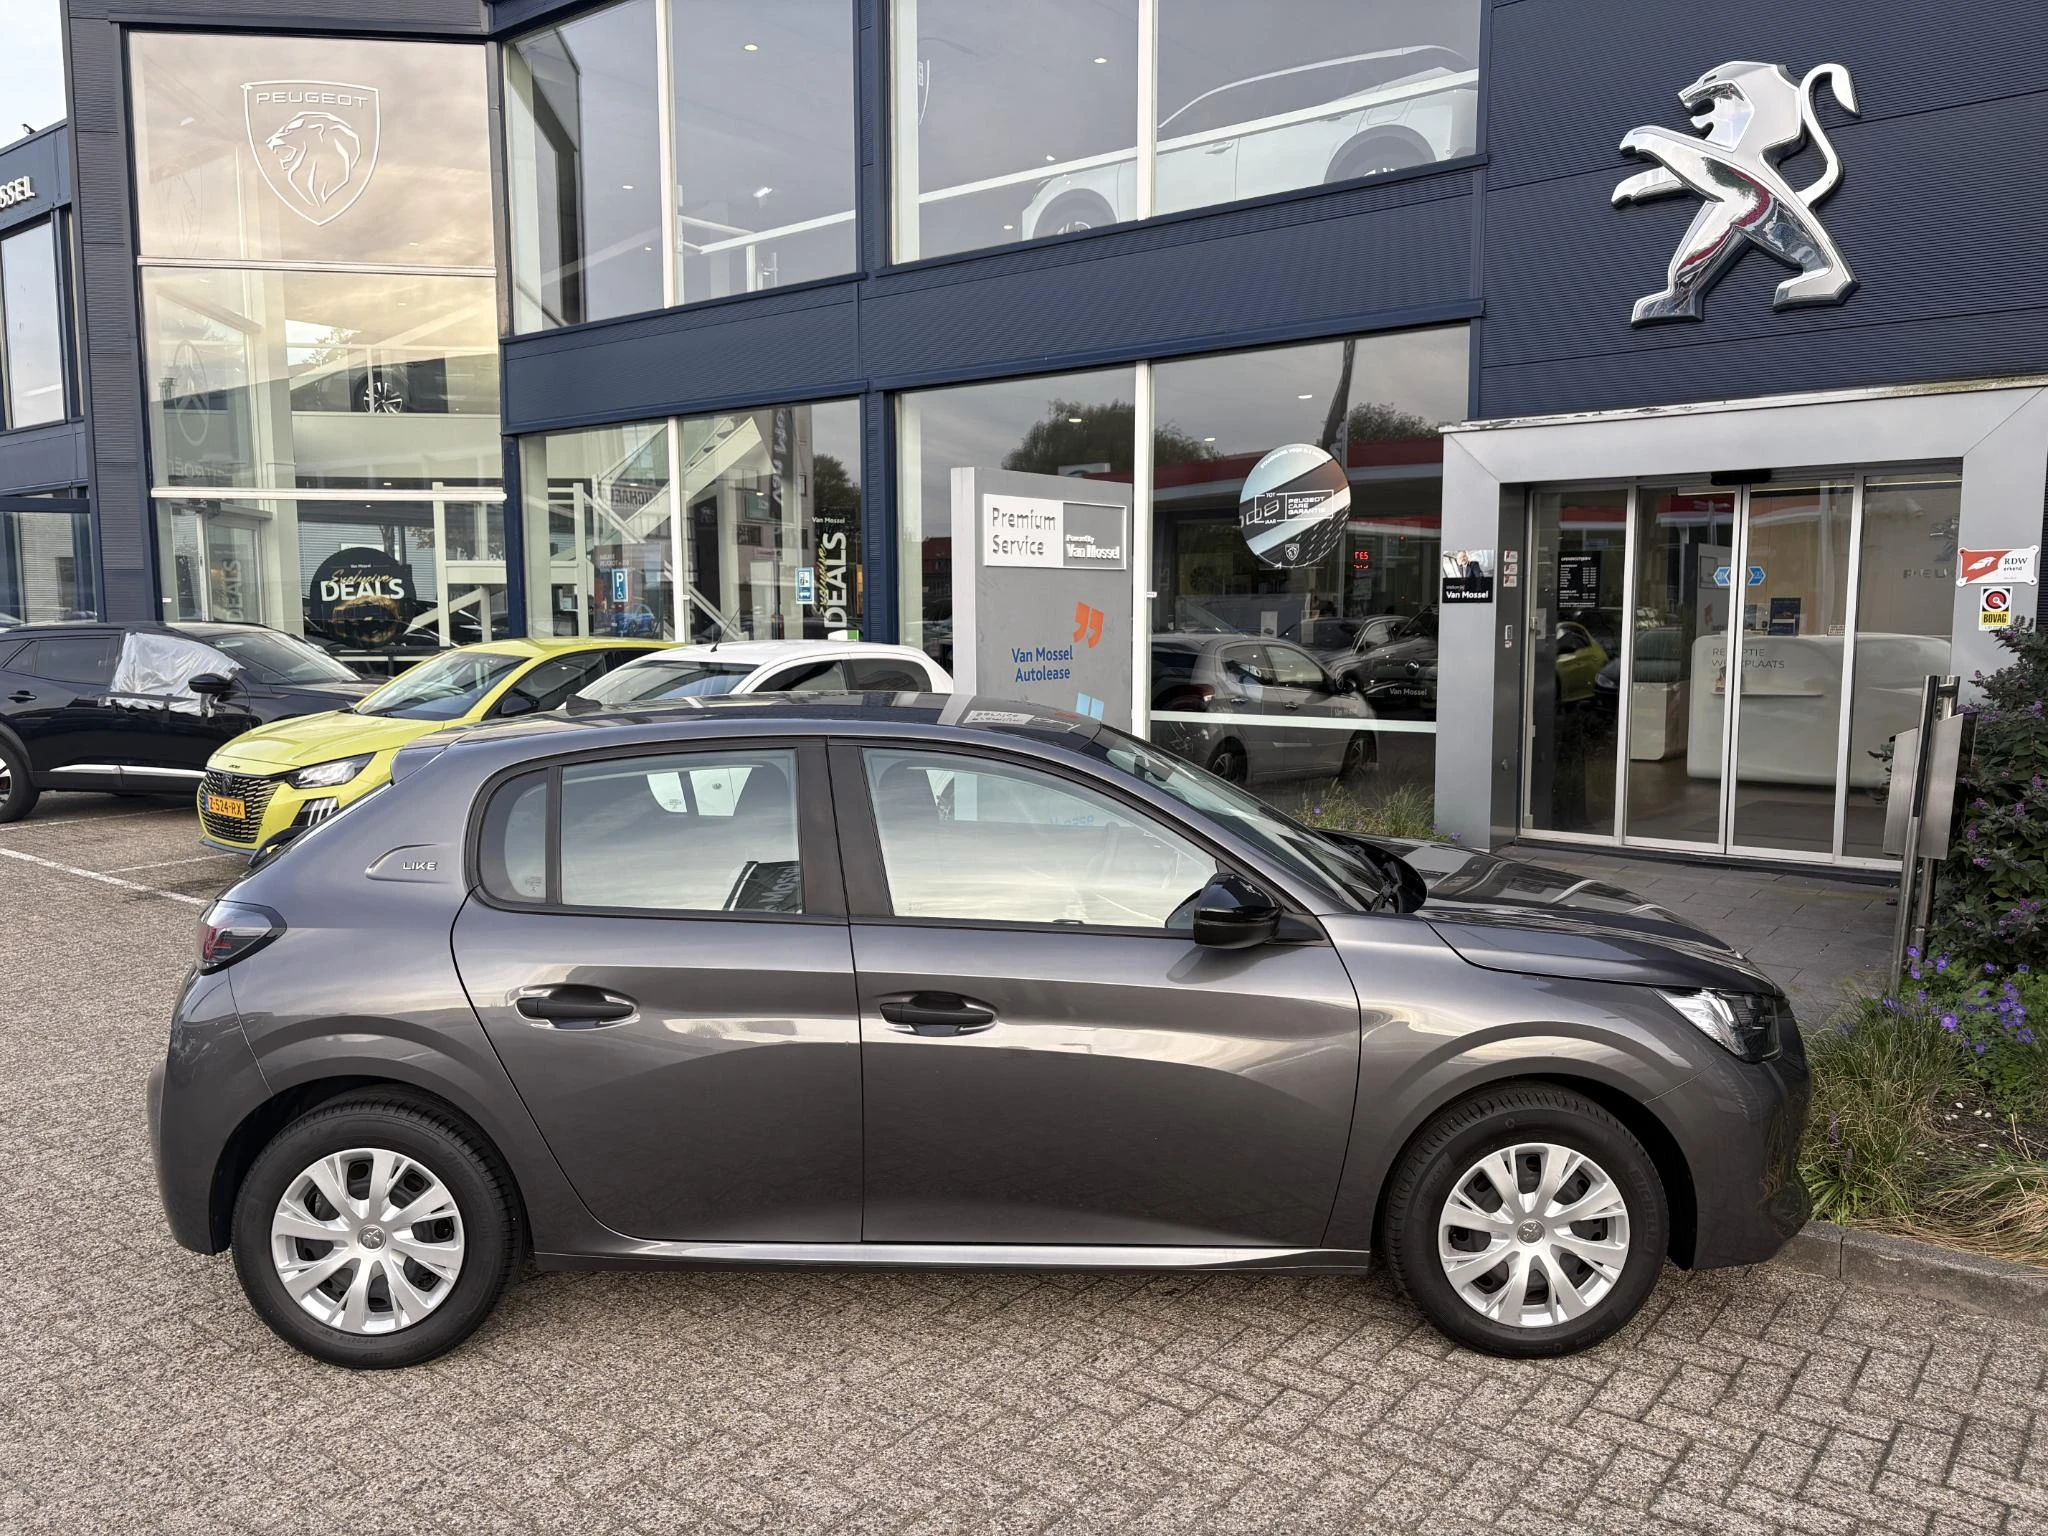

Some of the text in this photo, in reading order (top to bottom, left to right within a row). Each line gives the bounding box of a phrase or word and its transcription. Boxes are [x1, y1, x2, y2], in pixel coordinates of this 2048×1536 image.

[256, 91, 368, 107] PEUGEOT
[1288, 496, 1326, 504] PEUGEOT
[992, 507, 1056, 531] Premium
[992, 534, 1045, 556] Service
[1066, 543, 1120, 560] Van Mossel
[2004, 557, 2028, 565] RDW
[616, 572, 624, 588] P
[822, 531, 848, 629] DEALS
[320, 578, 406, 602] DEALS
[1445, 590, 1489, 599] Van Mossel
[1983, 613, 2007, 624] BOVAG
[1011, 644, 1073, 663] Van Mossel
[1015, 664, 1071, 683] Autolease
[1389, 687, 1428, 696] Van Mossel
[402, 861, 437, 871] LIKE
